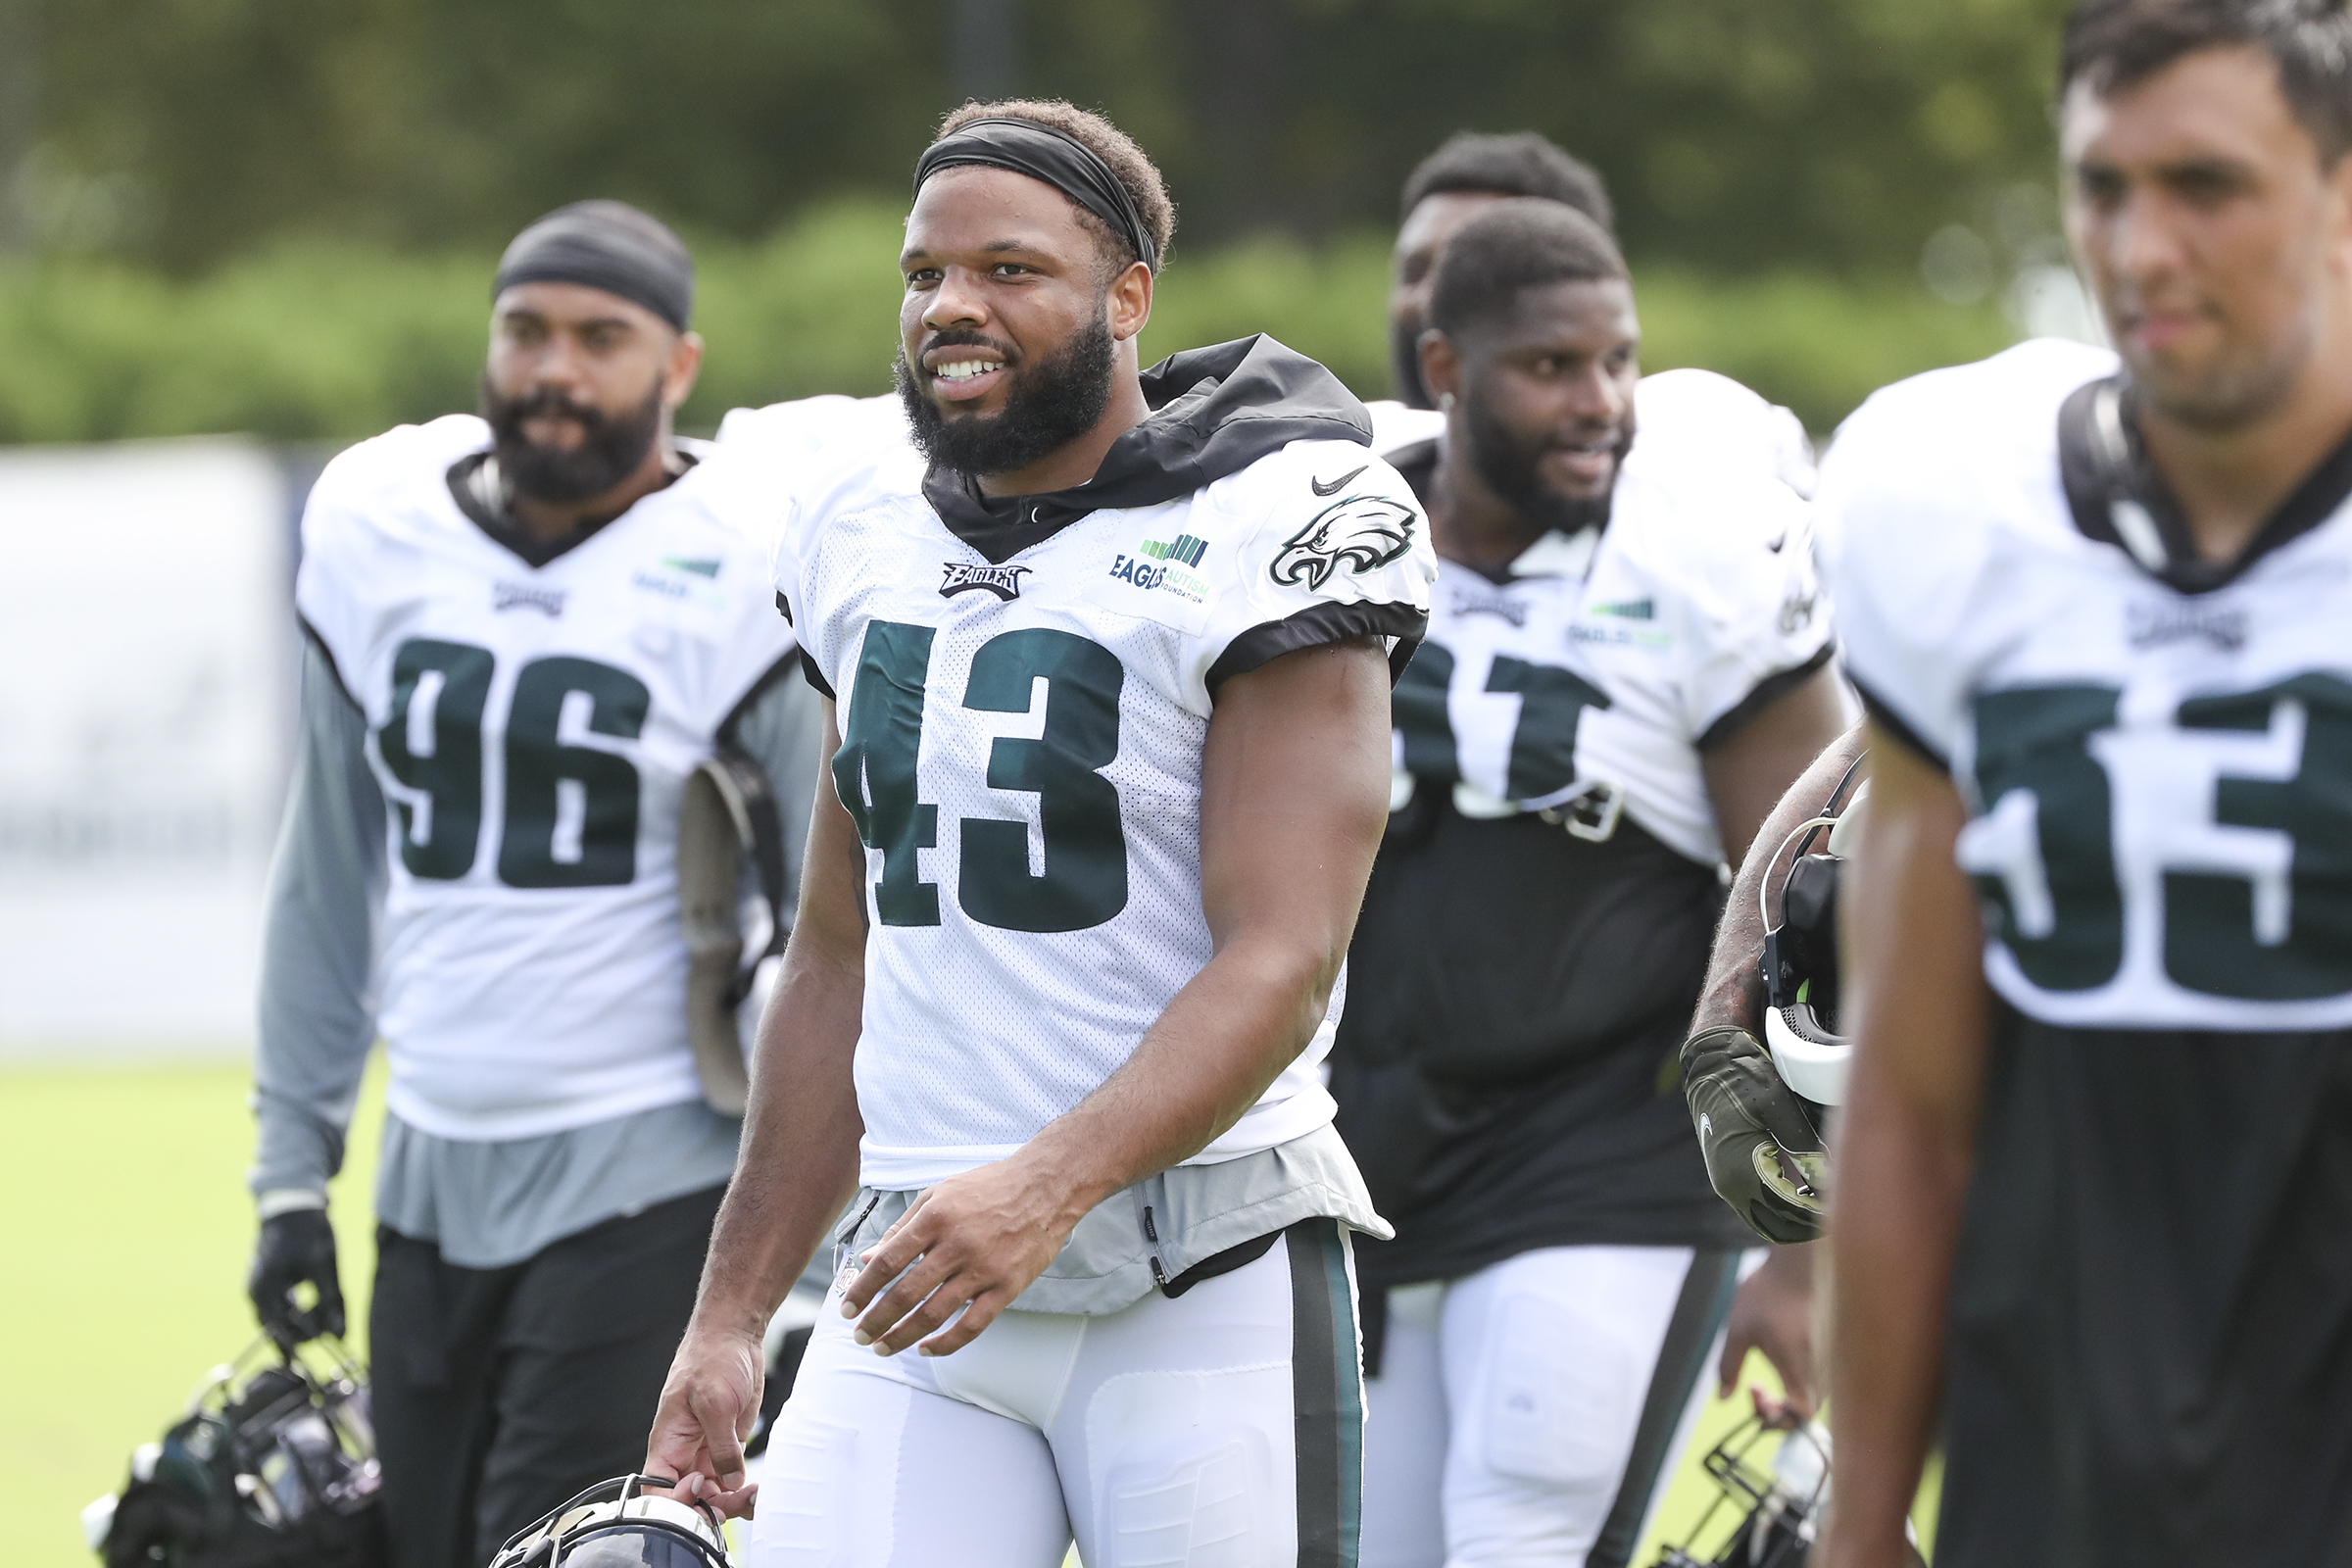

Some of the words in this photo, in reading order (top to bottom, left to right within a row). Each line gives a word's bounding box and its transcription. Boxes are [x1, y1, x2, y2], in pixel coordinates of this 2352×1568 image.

[940, 563, 1032, 601] EAGLES
[1108, 554, 1167, 590] EAGLS
[1165, 568, 1210, 596] AUTISM
[1160, 582, 1203, 604] FOUNDATION
[378, 638, 650, 888] 96
[831, 619, 1128, 933] 43
[1970, 672, 2352, 1002] 53
